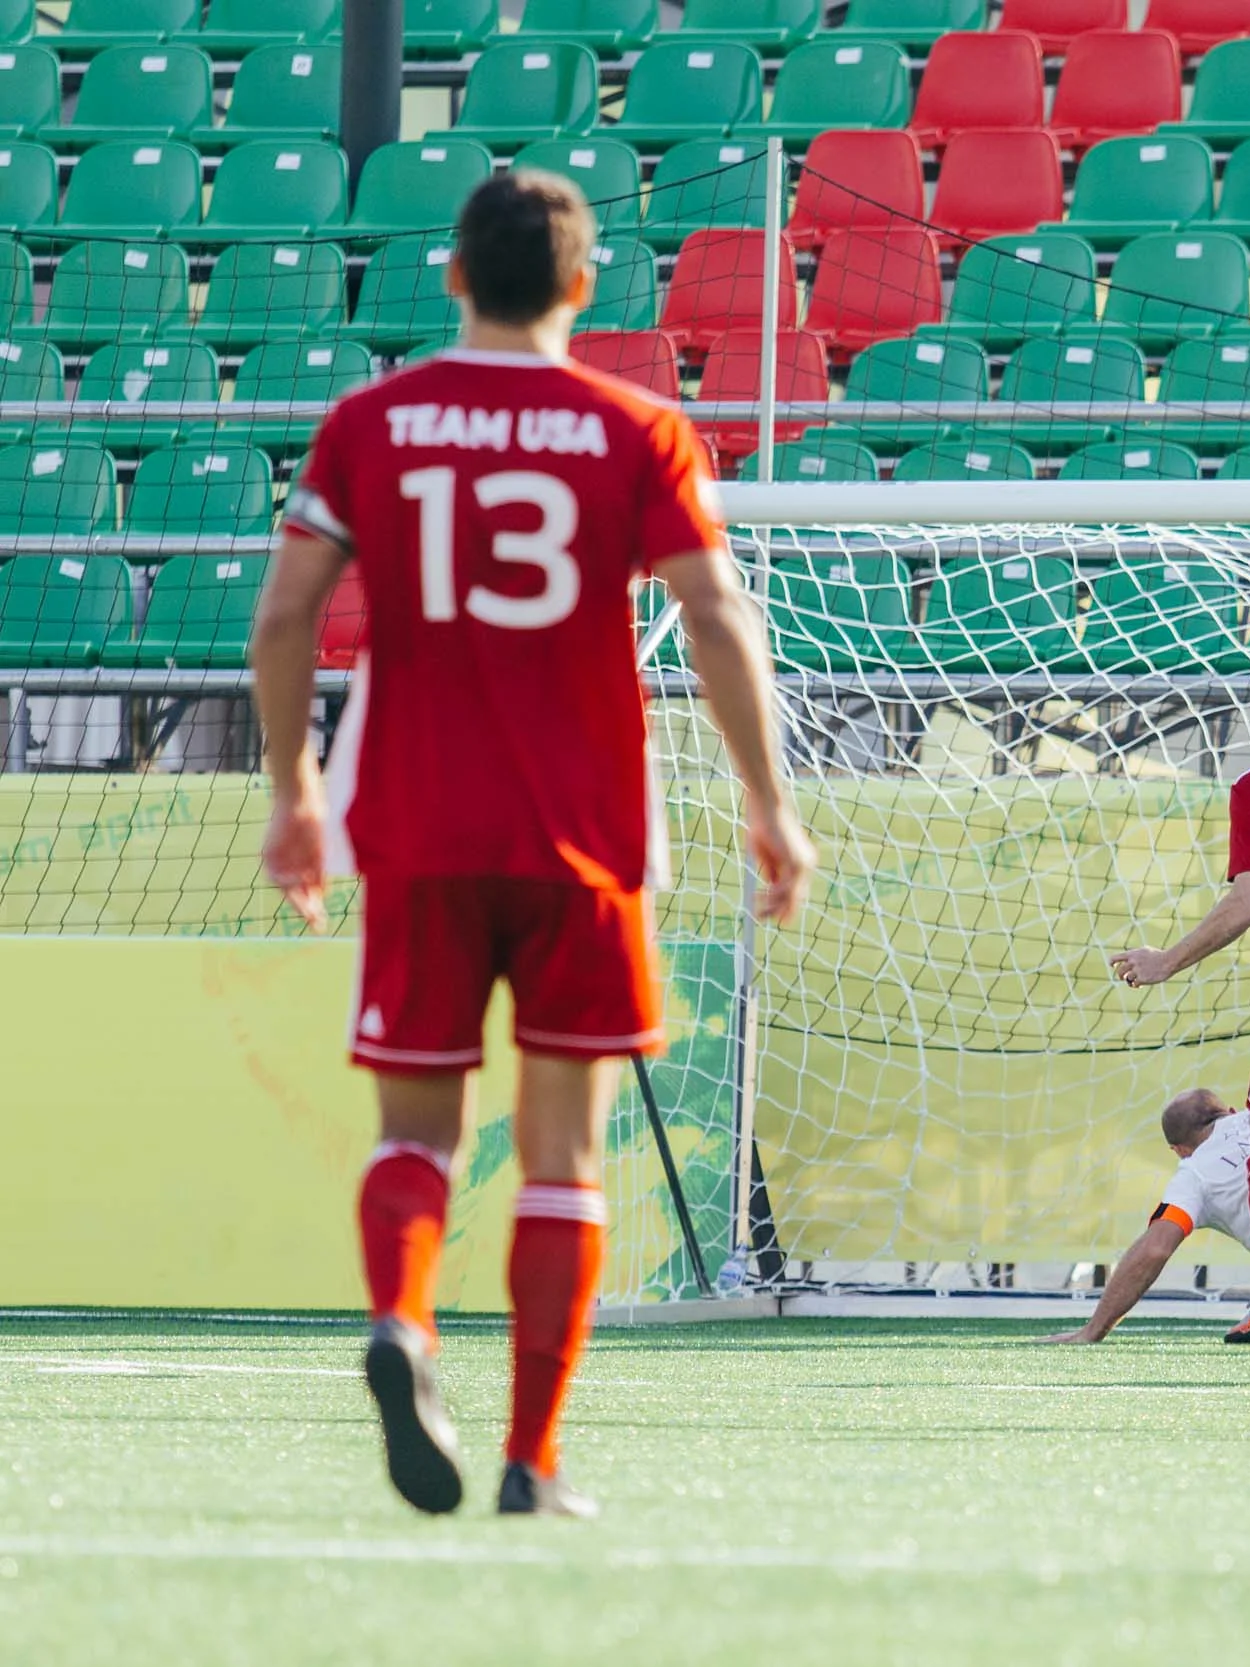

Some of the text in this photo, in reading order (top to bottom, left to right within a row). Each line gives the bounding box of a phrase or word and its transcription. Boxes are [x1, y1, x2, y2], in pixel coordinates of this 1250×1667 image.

[386, 403, 609, 458] TEAM USA
[400, 466, 582, 630] 13
